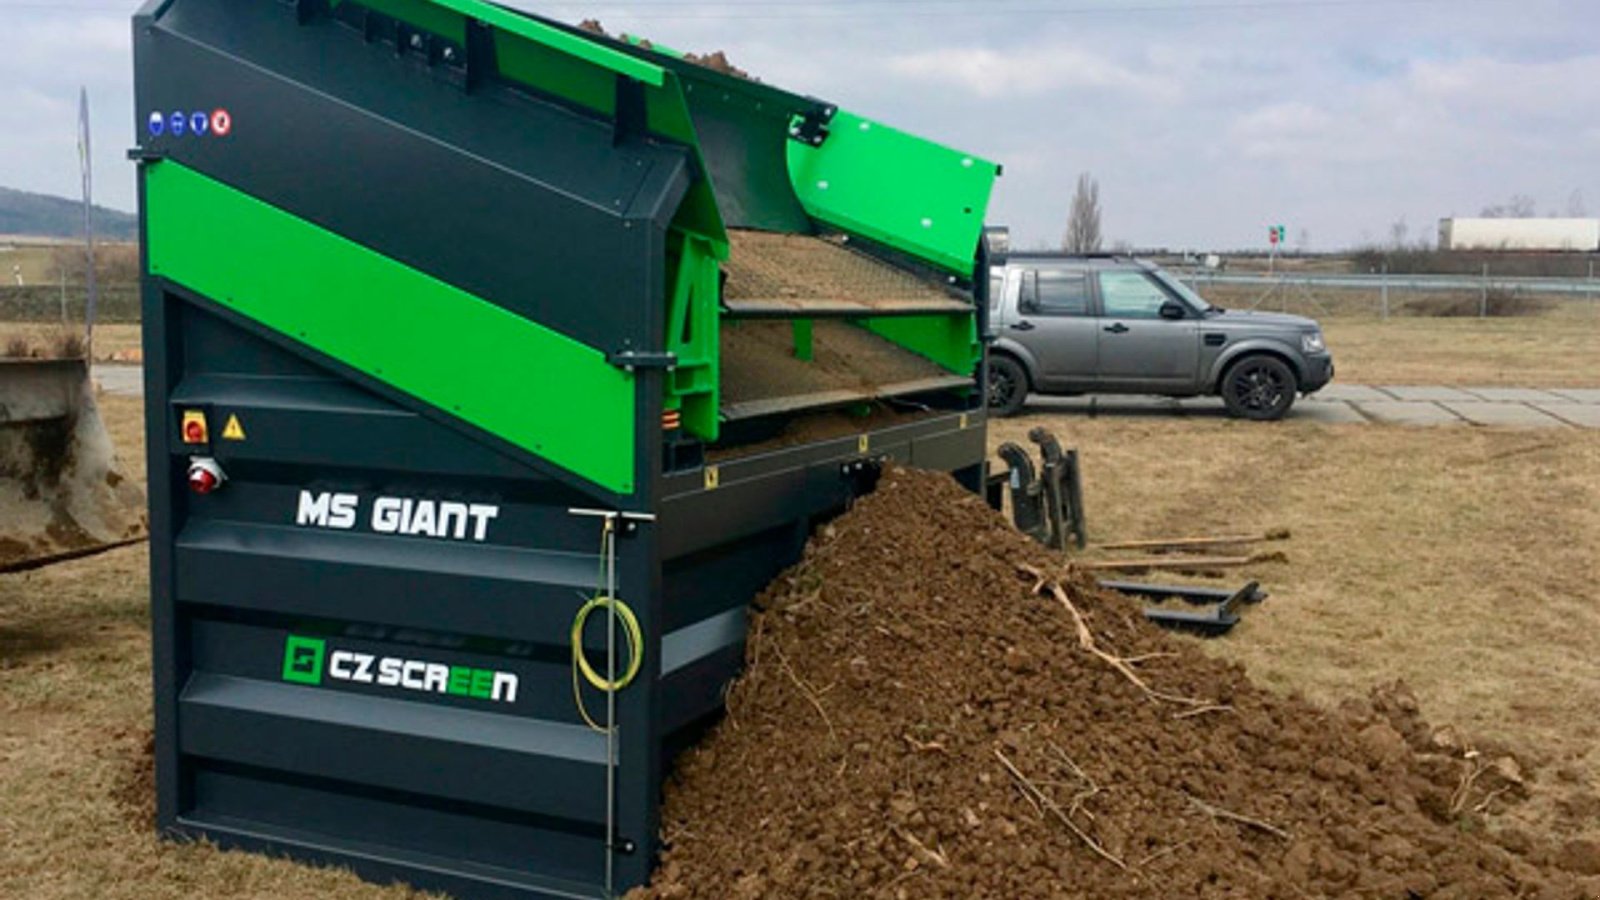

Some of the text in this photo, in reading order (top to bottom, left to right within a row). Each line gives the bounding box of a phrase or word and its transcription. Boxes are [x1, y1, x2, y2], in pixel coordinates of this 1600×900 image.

[296, 490, 499, 541] MS GIANT
[329, 650, 519, 702] CZ SCREEN
